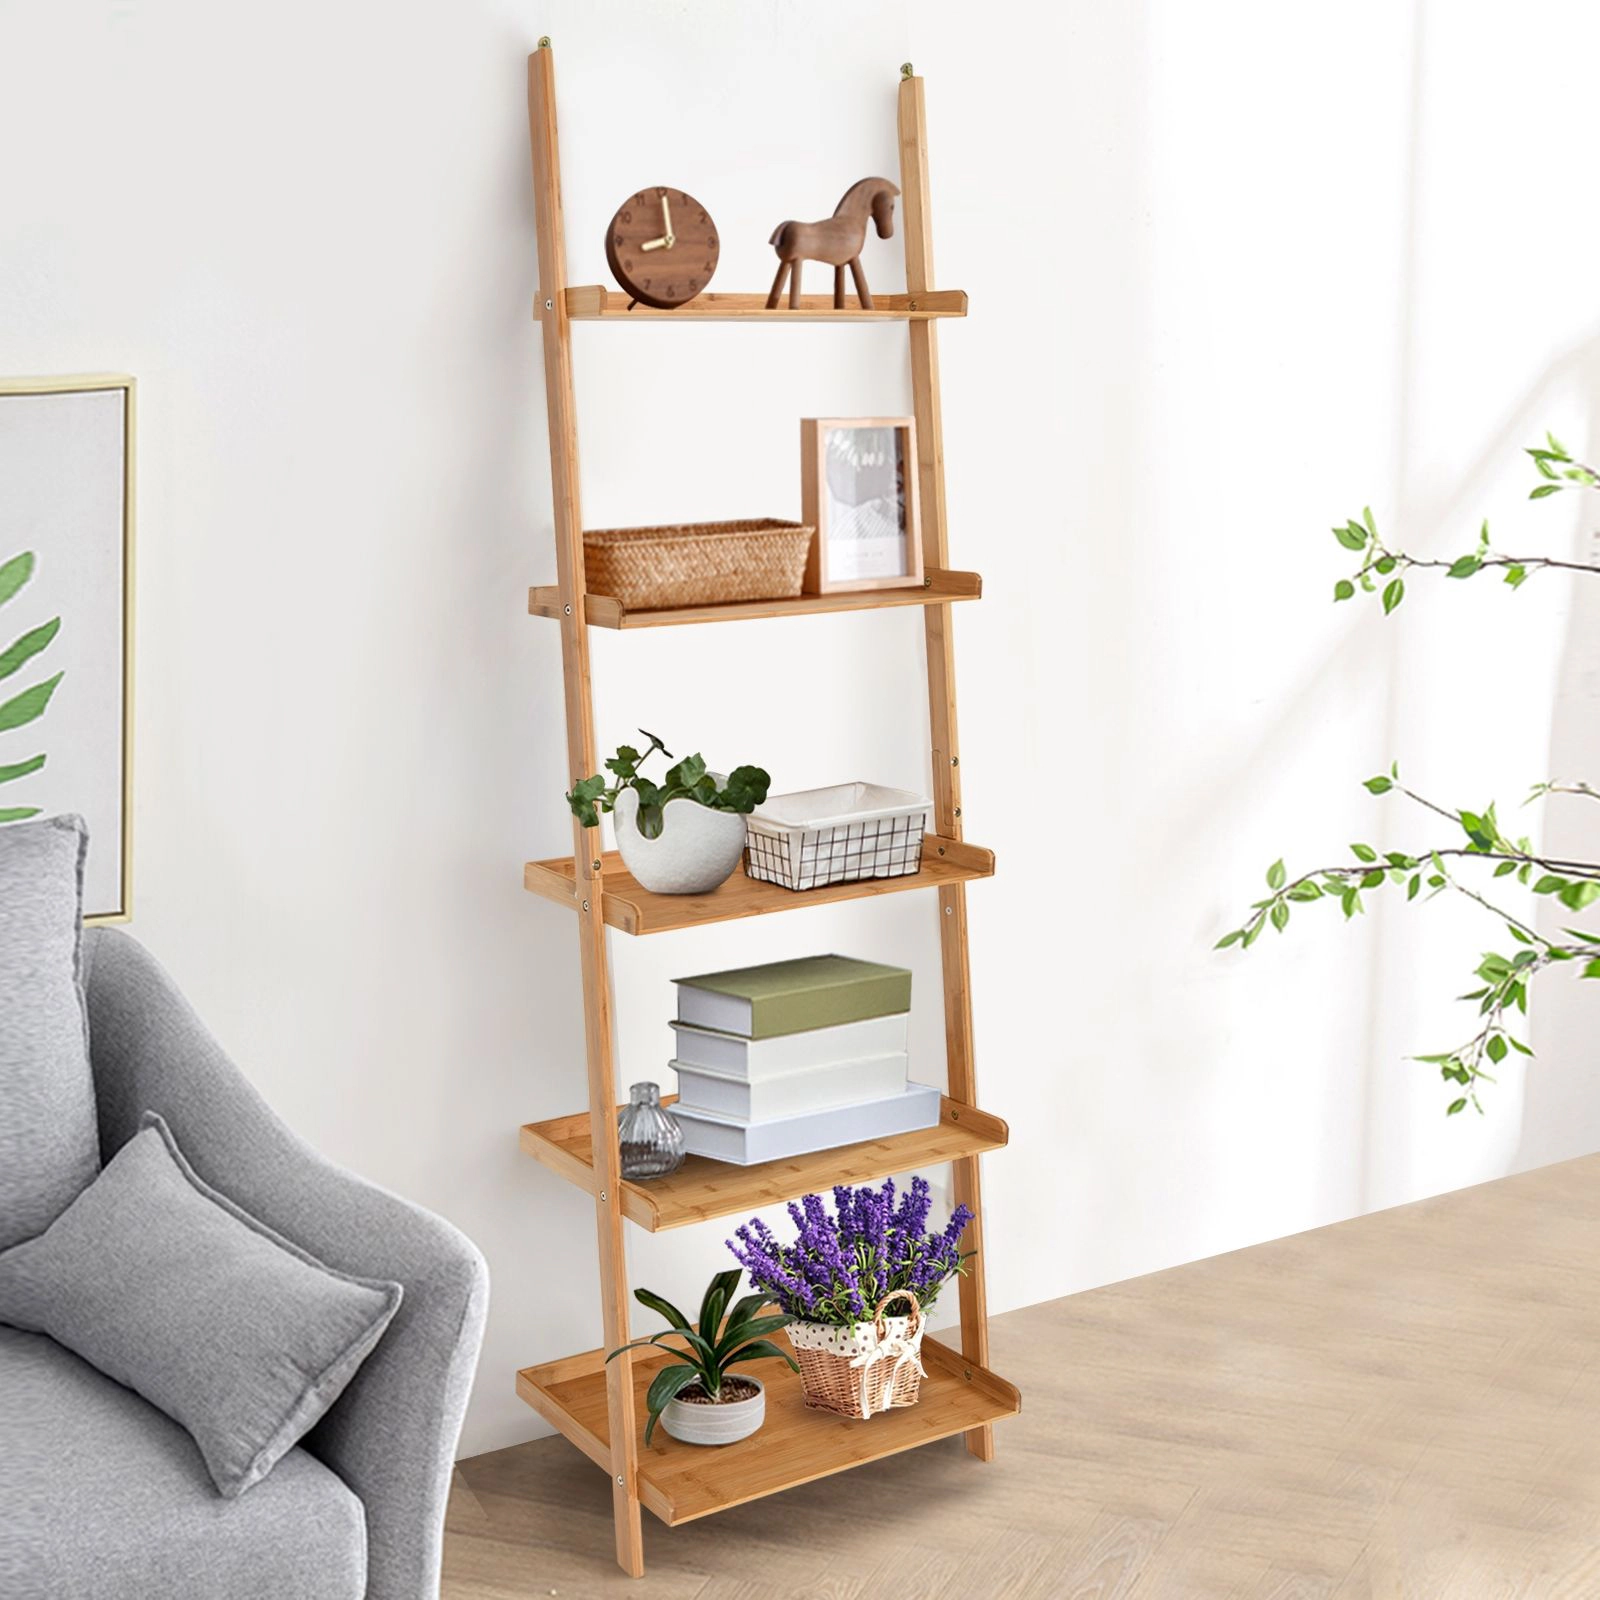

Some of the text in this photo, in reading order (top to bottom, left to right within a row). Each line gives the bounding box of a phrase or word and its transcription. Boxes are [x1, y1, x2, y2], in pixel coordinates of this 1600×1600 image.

[635, 194, 645, 206] 11
[620, 212, 632, 224] 10
[698, 212, 707, 224] 2
[704, 262, 712, 272] 4
[643, 279, 651, 290] 7
[688, 279, 697, 291] 5
[666, 285, 675, 298] 6
